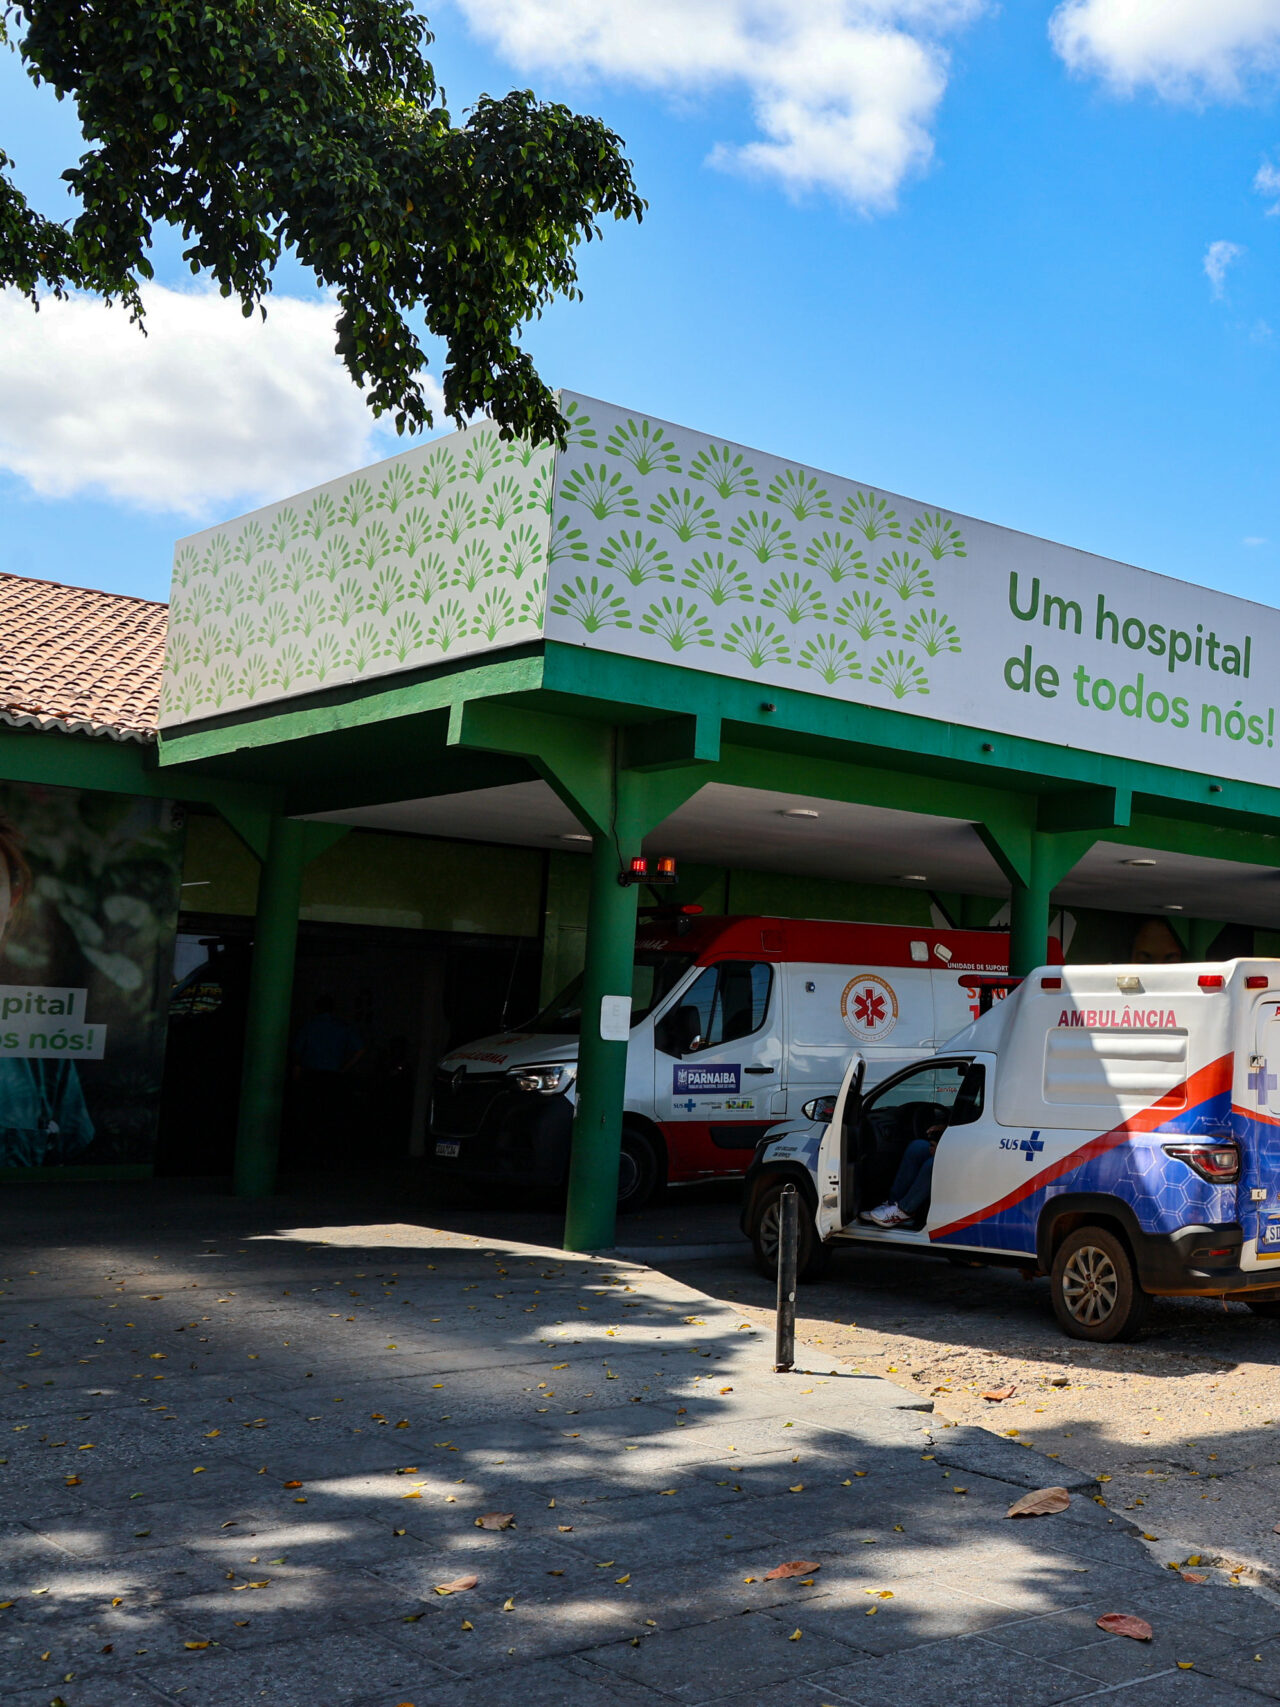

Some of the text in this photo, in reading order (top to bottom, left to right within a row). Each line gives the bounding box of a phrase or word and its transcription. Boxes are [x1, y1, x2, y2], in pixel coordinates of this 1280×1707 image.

[1008, 571, 1252, 679] Um hospital
[1003, 644, 1275, 748] de todos nós!
[947, 962, 1009, 972] UNIDADE DE SUPORT
[2, 991, 75, 1020] pital
[1057, 1004, 1177, 1028] AMBULÂNCIA
[28, 1028, 95, 1052] nós!
[998, 1138, 1020, 1151] SUS
